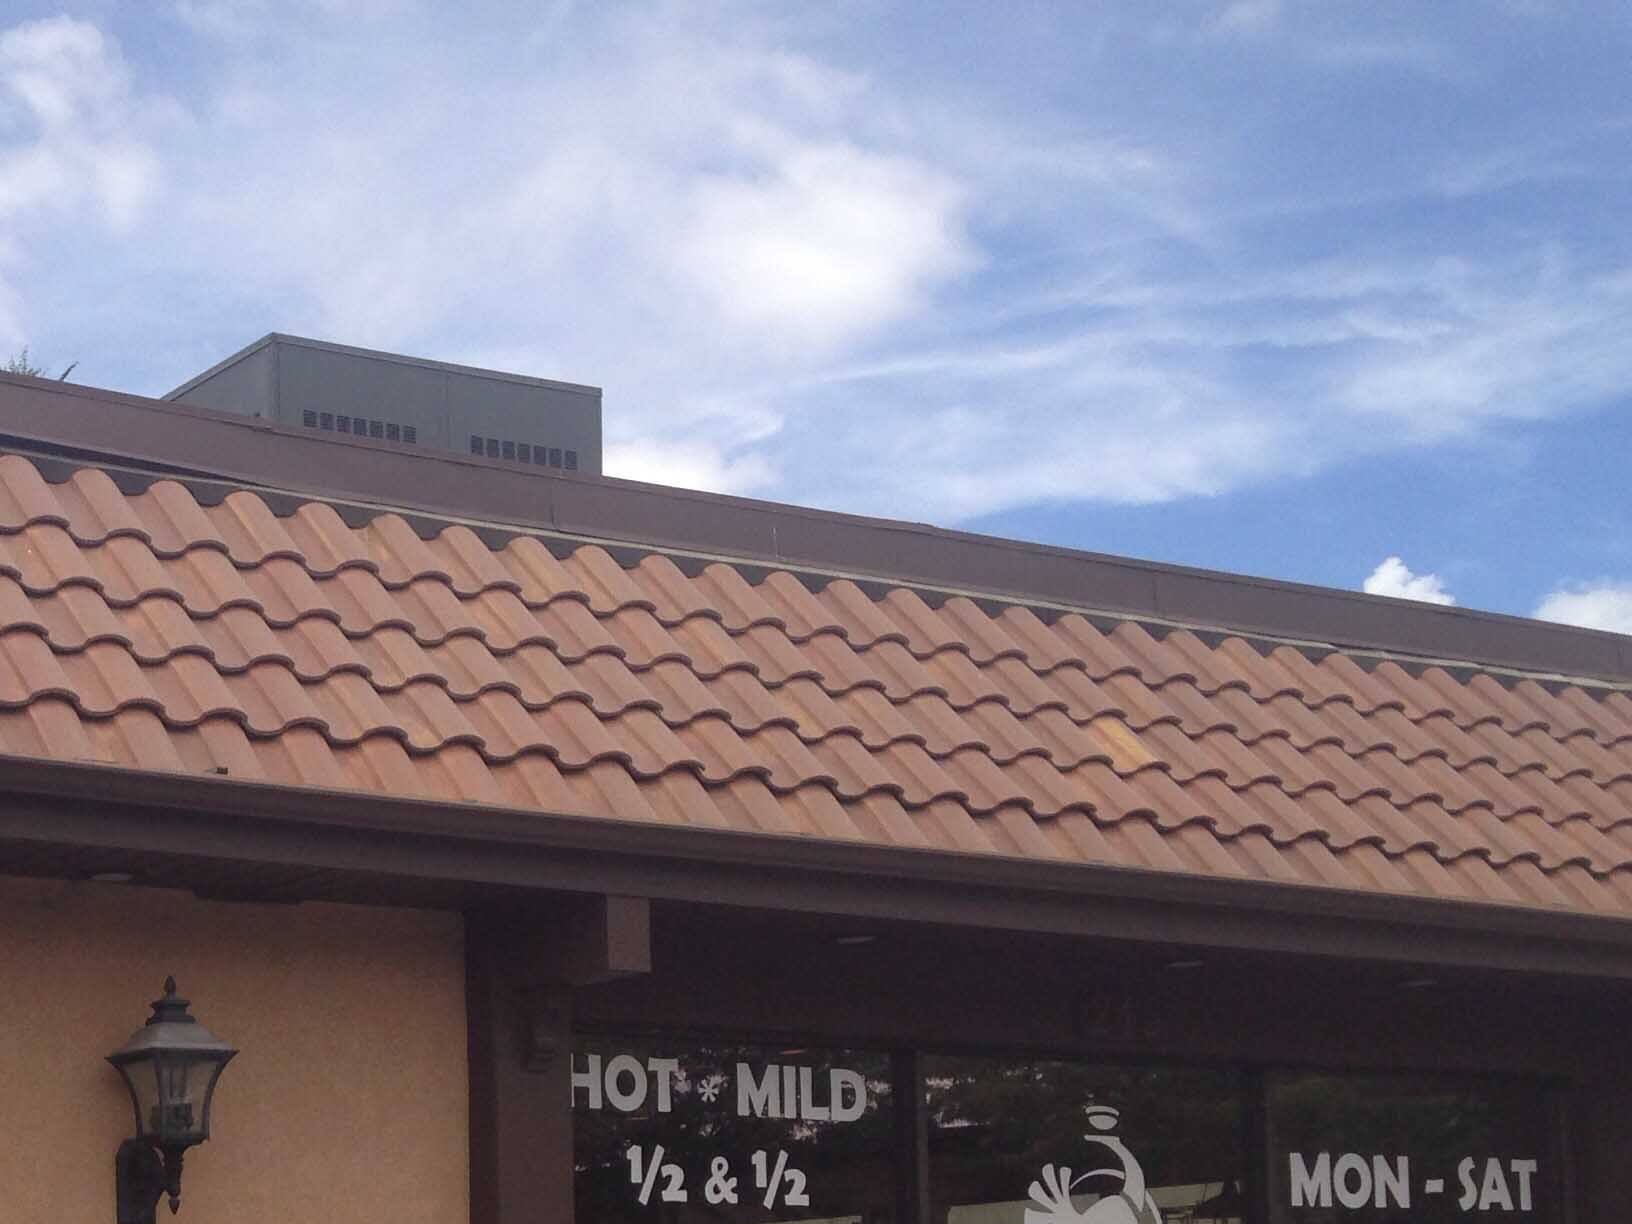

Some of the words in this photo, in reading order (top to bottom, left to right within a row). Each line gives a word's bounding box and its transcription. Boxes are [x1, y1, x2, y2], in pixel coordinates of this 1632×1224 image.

[571, 1054, 679, 1113] HOT
[736, 1063, 868, 1122] MILD
[704, 1156, 738, 1204] &
[1289, 1152, 1411, 1209] MON
[1457, 1156, 1537, 1212] SAT
